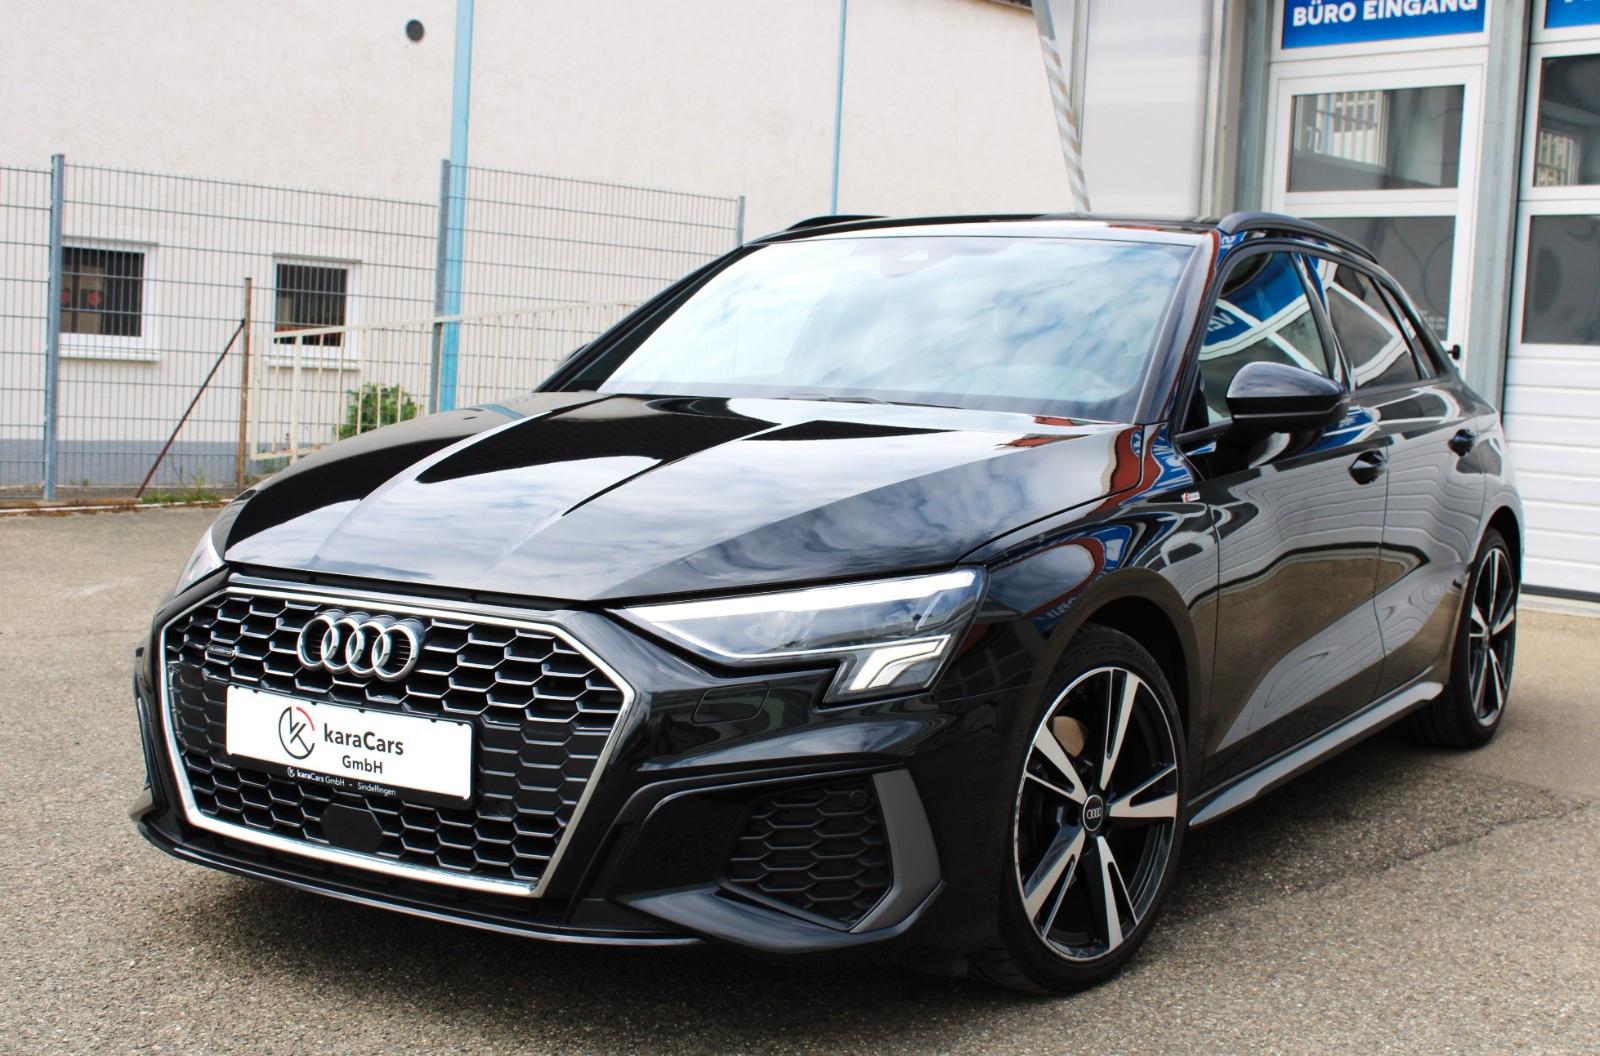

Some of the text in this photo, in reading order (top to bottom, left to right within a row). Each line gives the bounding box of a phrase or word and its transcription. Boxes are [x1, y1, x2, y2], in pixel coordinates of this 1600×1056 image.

[1293, 0, 1477, 26] BÜRO EINGANG
[324, 723, 404, 755] karaCars
[342, 755, 383, 774] GmbH
[296, 769, 324, 783] karaCars
[325, 776, 345, 787] GmbH
